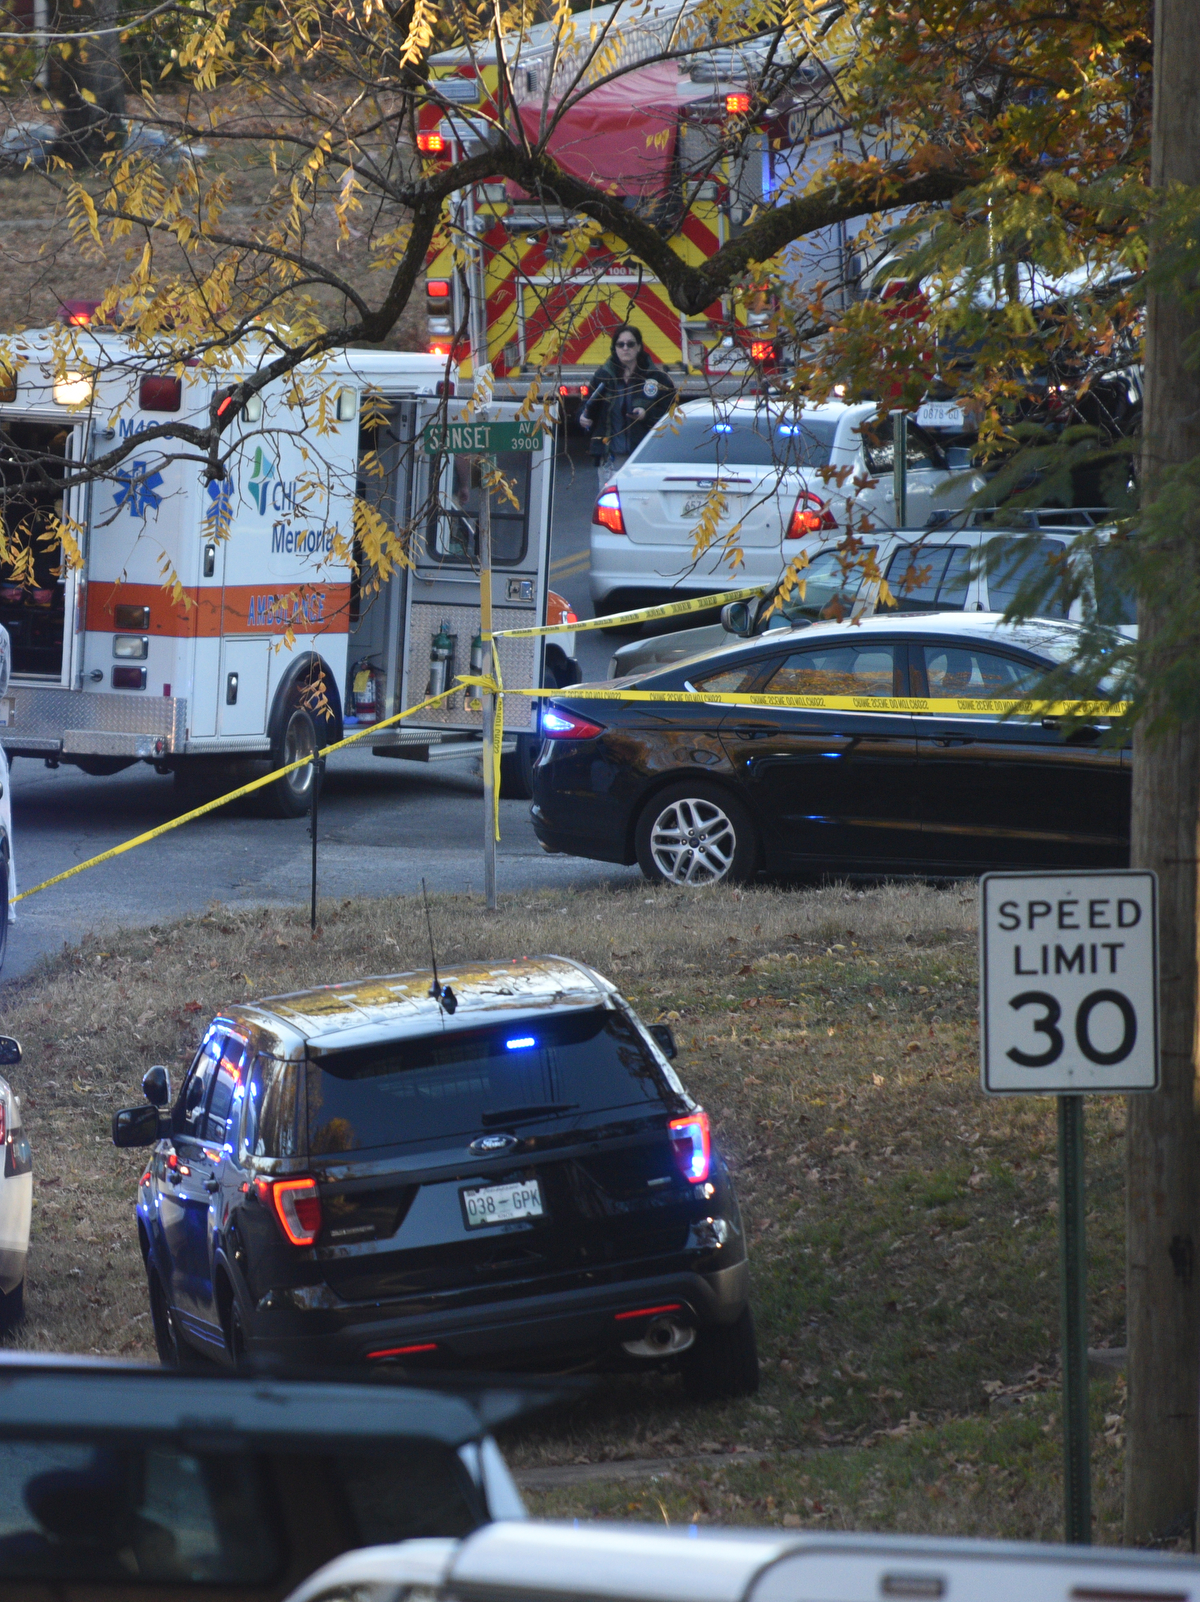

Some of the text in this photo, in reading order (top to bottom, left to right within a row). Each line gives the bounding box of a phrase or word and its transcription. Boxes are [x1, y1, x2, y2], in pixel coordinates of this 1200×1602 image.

[609, 267, 625, 275] 100
[519, 423, 530, 433] AV
[511, 438, 539, 449] 3900
[272, 482, 297, 511] CHI
[998, 898, 1142, 931] SPEED
[1014, 943, 1125, 975] LIMIT
[1006, 988, 1138, 1068] 30
